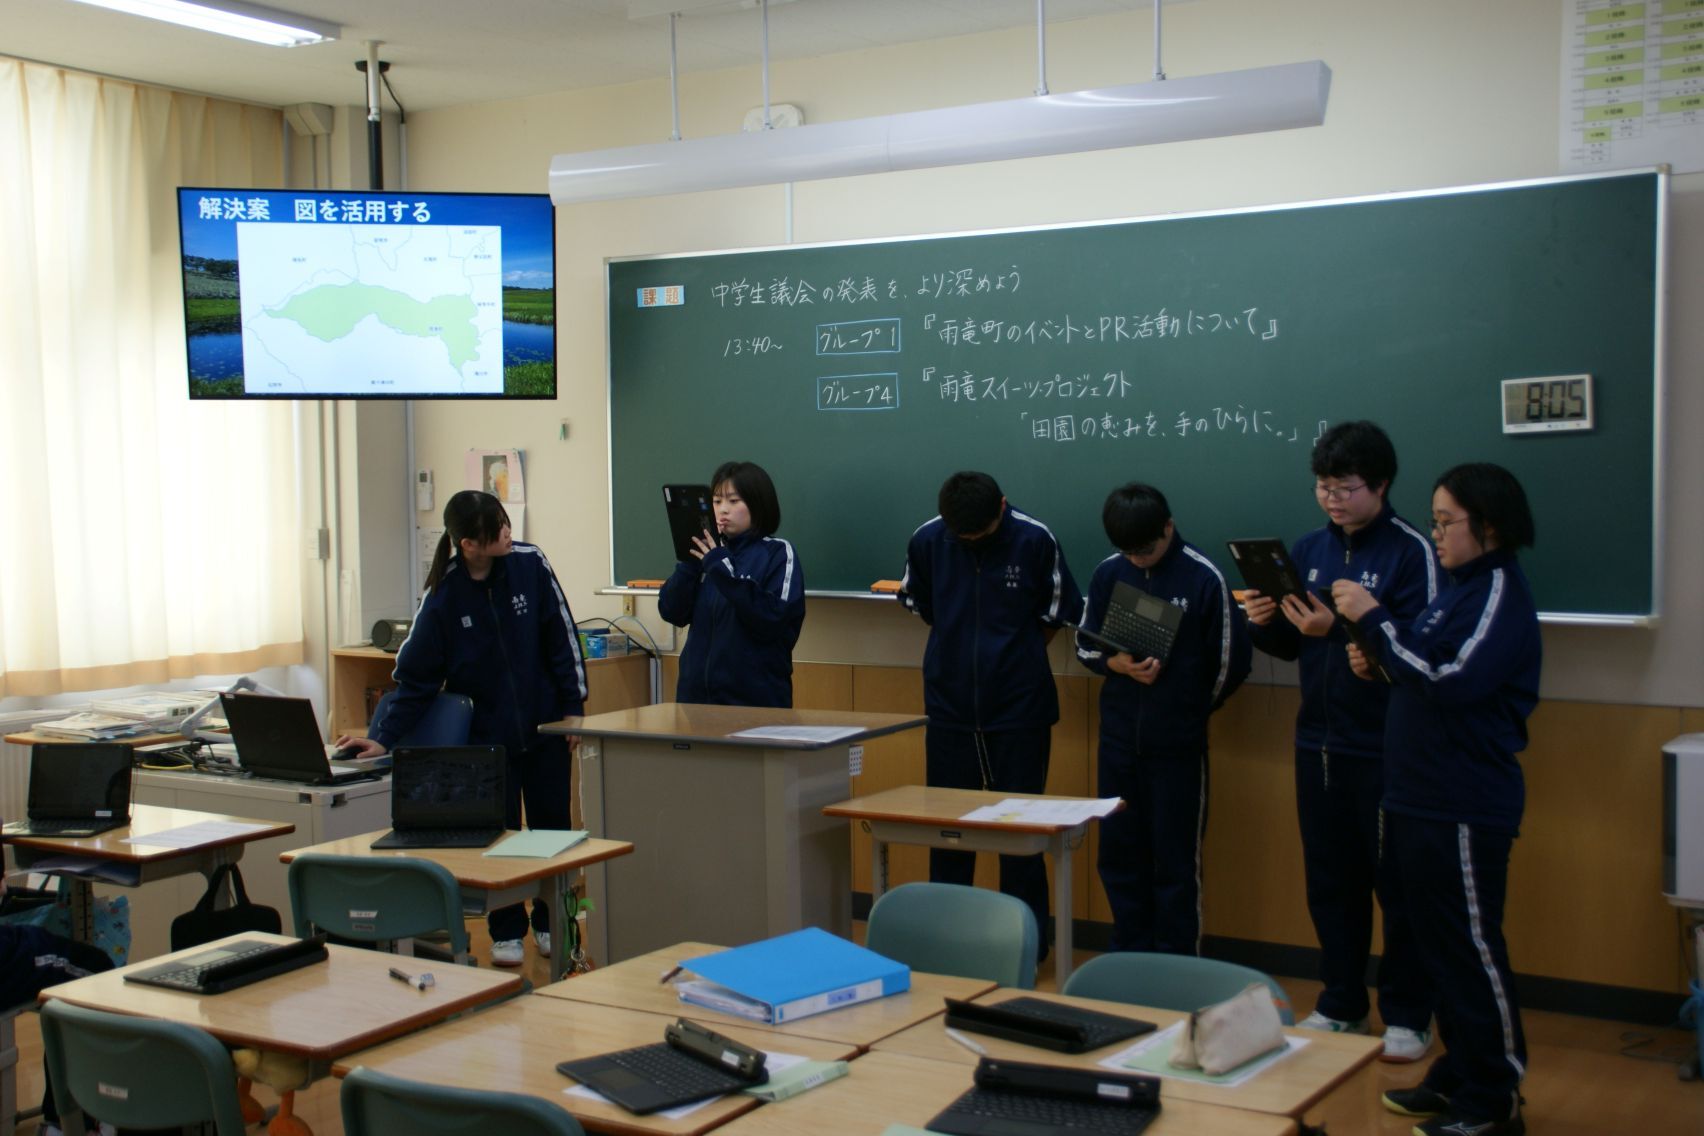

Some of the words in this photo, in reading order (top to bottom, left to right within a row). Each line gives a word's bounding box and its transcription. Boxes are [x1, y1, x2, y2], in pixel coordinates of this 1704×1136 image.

[199, 197, 271, 221] 解決案
[294, 199, 432, 223] 図を活用する
[642, 286, 680, 305] 課題
